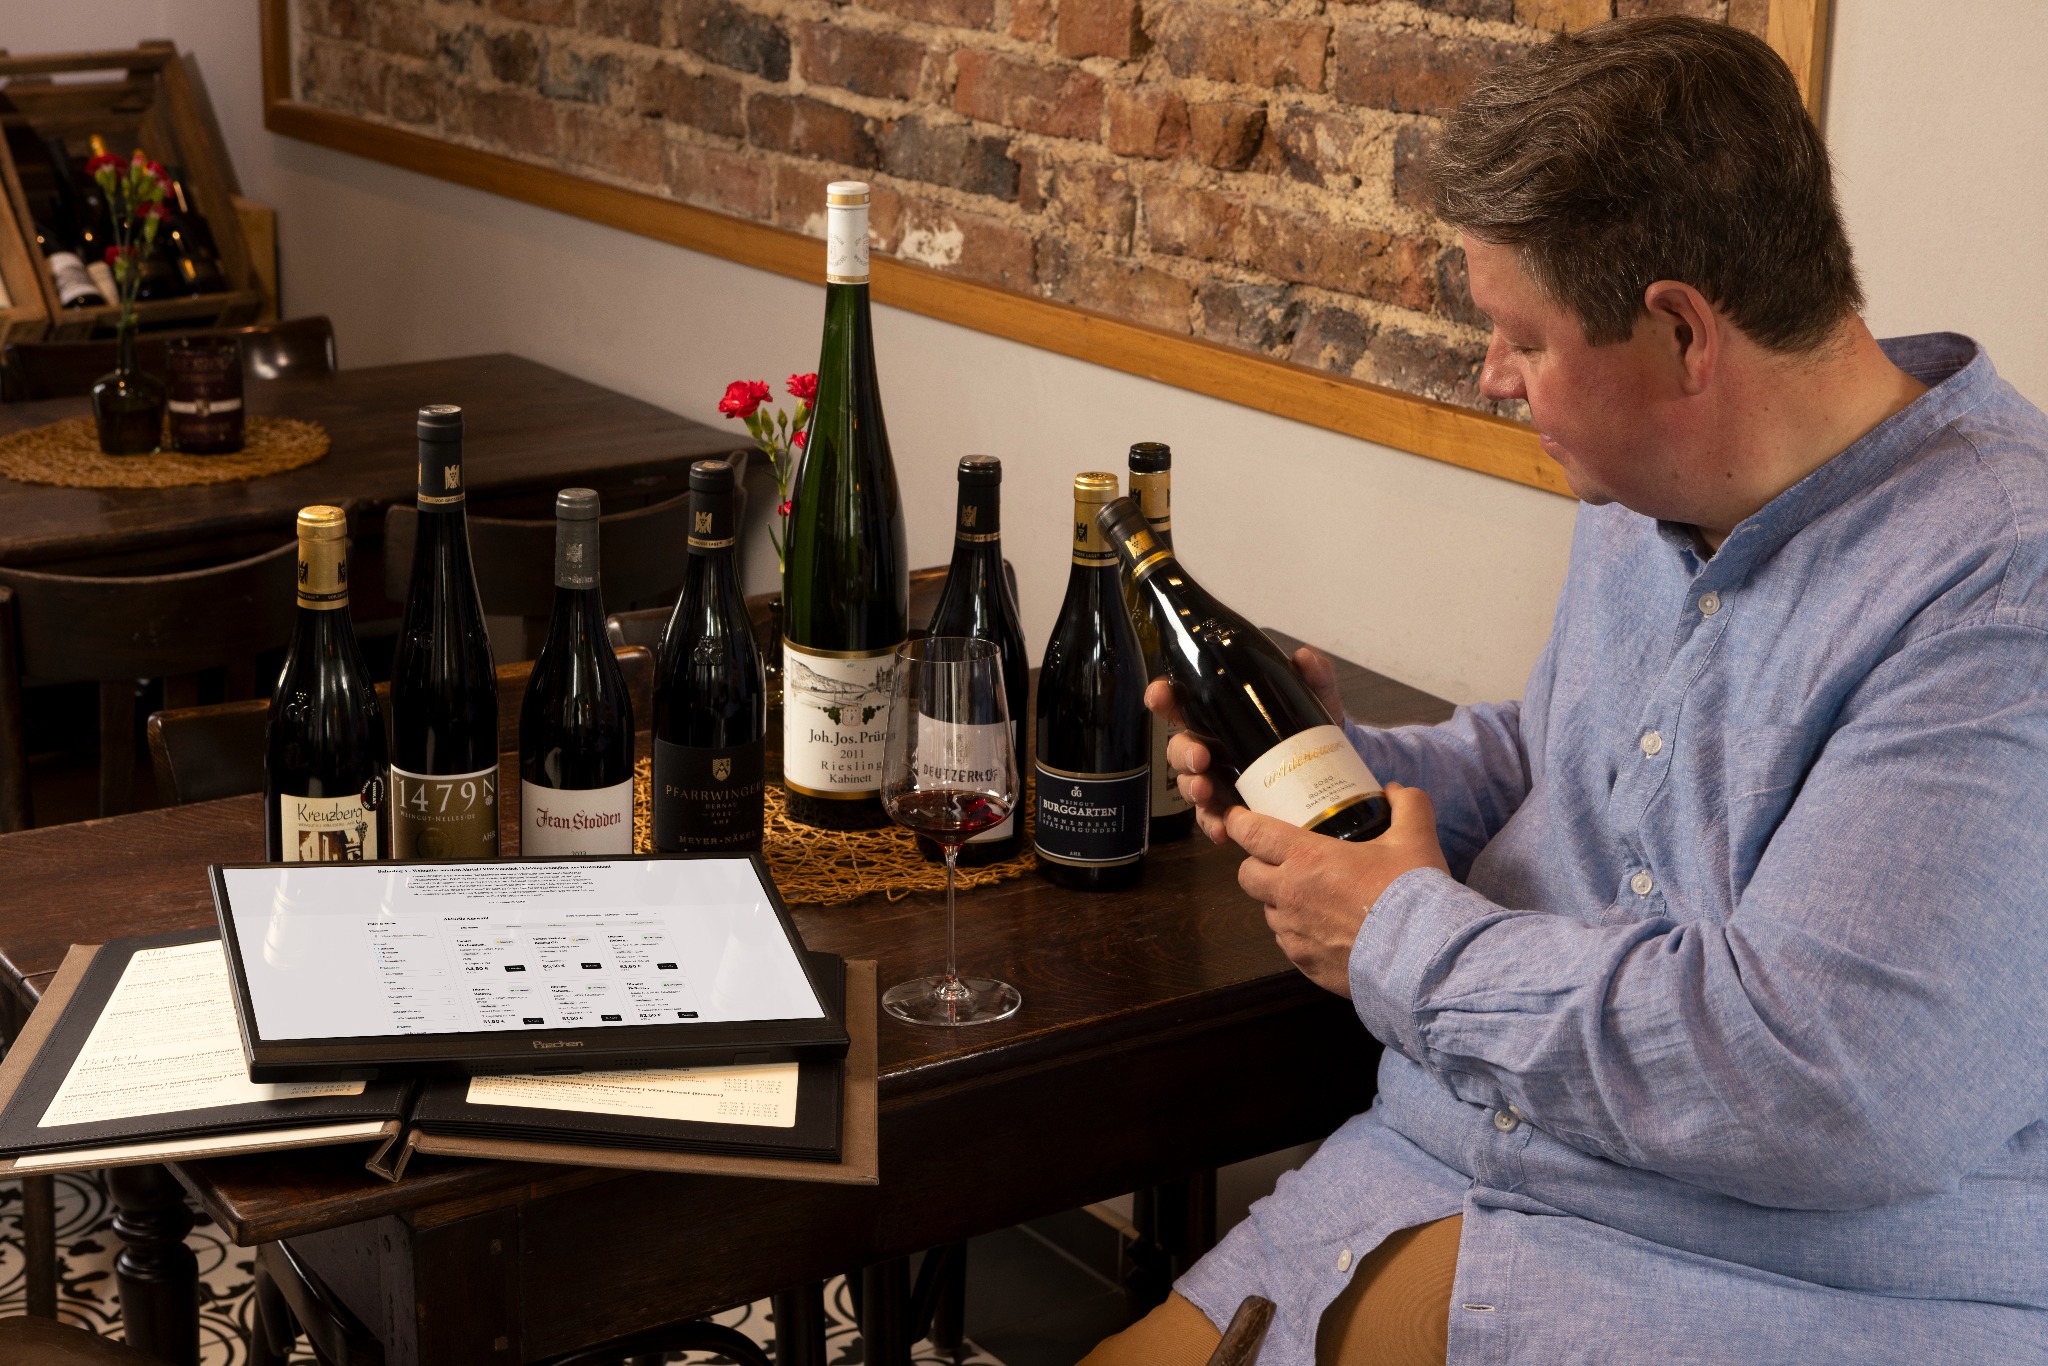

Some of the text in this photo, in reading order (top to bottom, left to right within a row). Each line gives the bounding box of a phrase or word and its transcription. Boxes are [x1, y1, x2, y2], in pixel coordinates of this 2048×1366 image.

[840, 750, 864, 759] 2011
[821, 760, 882, 771] Riesling
[923, 763, 998, 783] DEUTZERHOF
[829, 773, 872, 784] Kabinett
[399, 779, 476, 813] 1479
[1060, 798, 1094, 807] WEINGUT
[297, 802, 363, 825] Kreuzberg
[1042, 798, 1118, 818] BURGGARTEN
[536, 807, 621, 832] Jean Stodden
[1042, 812, 1117, 828] SONNENBERG
[483, 830, 496, 842] AHR
